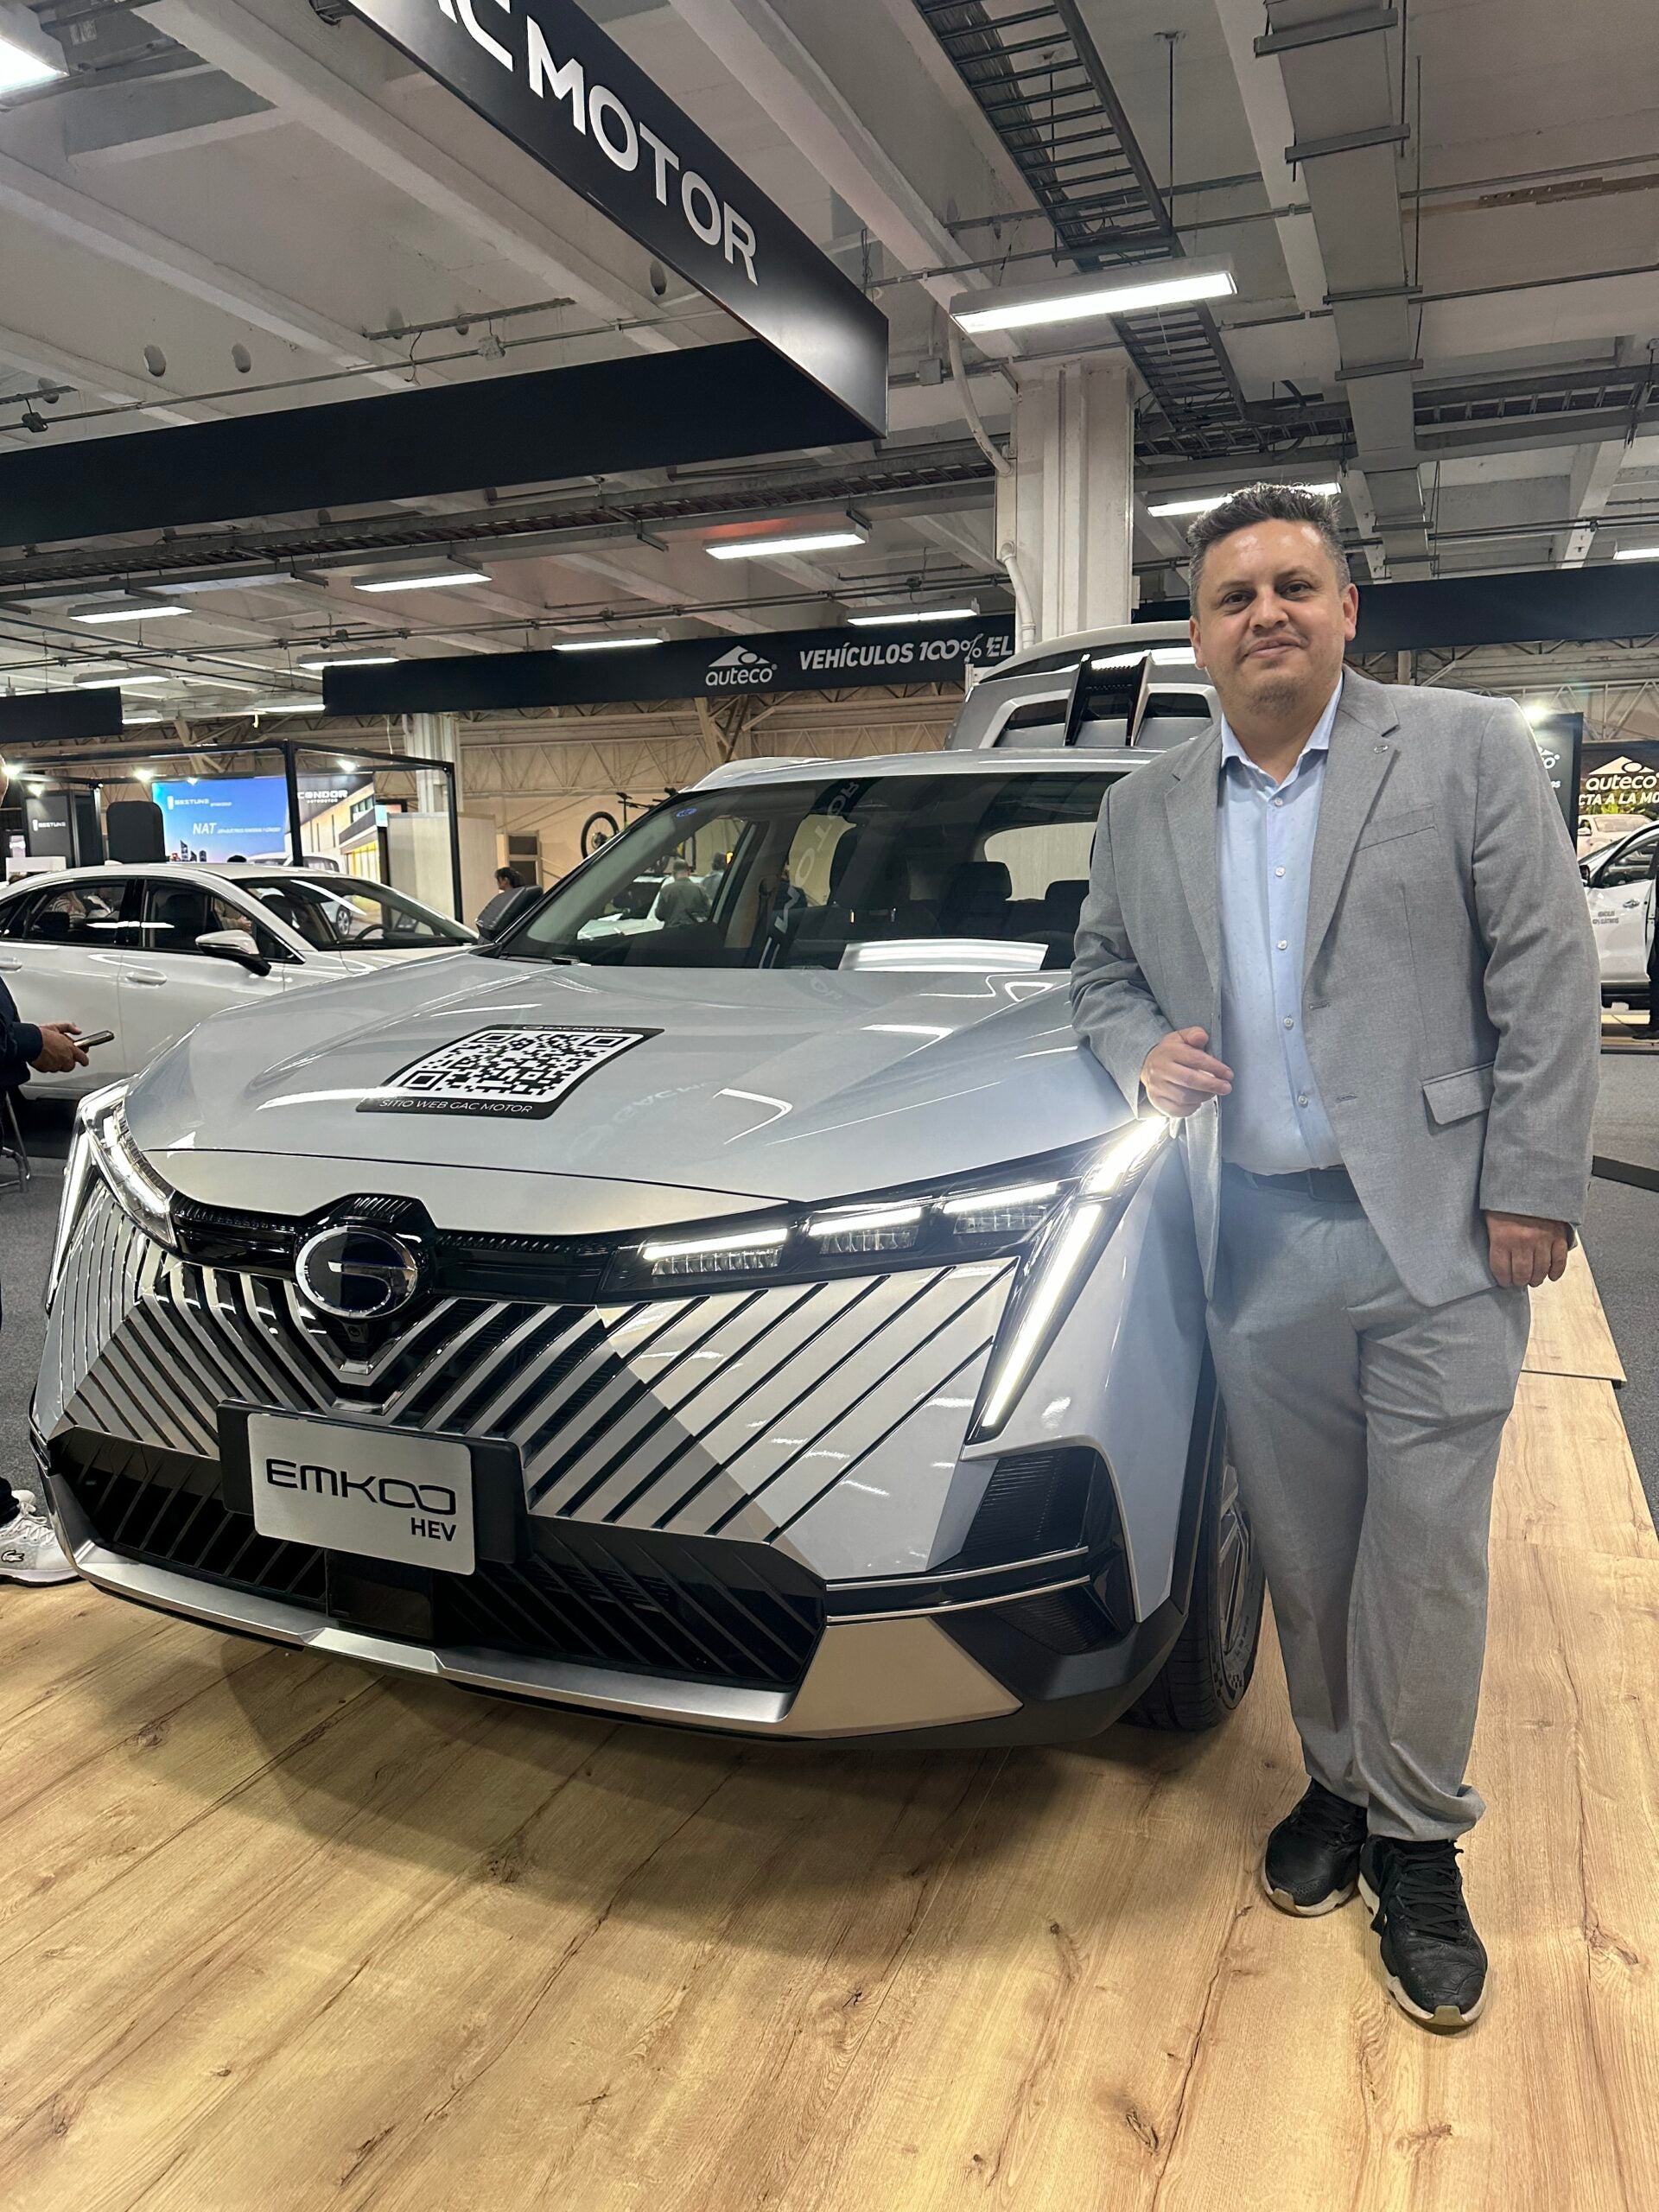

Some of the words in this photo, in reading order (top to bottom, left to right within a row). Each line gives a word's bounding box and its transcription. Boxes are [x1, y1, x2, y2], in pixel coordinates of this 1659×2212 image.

[436, 0, 513, 73] C
[526, 15, 759, 285] MOTOR
[799, 642, 913, 671] VEHÍCULOS
[919, 633, 984, 664] 100%
[705, 668, 772, 686] auteco
[1586, 775, 1657, 791] auteco
[297, 789, 348, 799] CONDOR
[1605, 793, 1616, 805] A
[1618, 792, 1637, 804] LA
[192, 822, 217, 835] NAT
[416, 1100, 448, 1109] WEB
[449, 1102, 480, 1110] GAC
[480, 1103, 533, 1113] MOTOR
[265, 1458, 457, 1516] EMKOO
[410, 1516, 457, 1541] HEV
